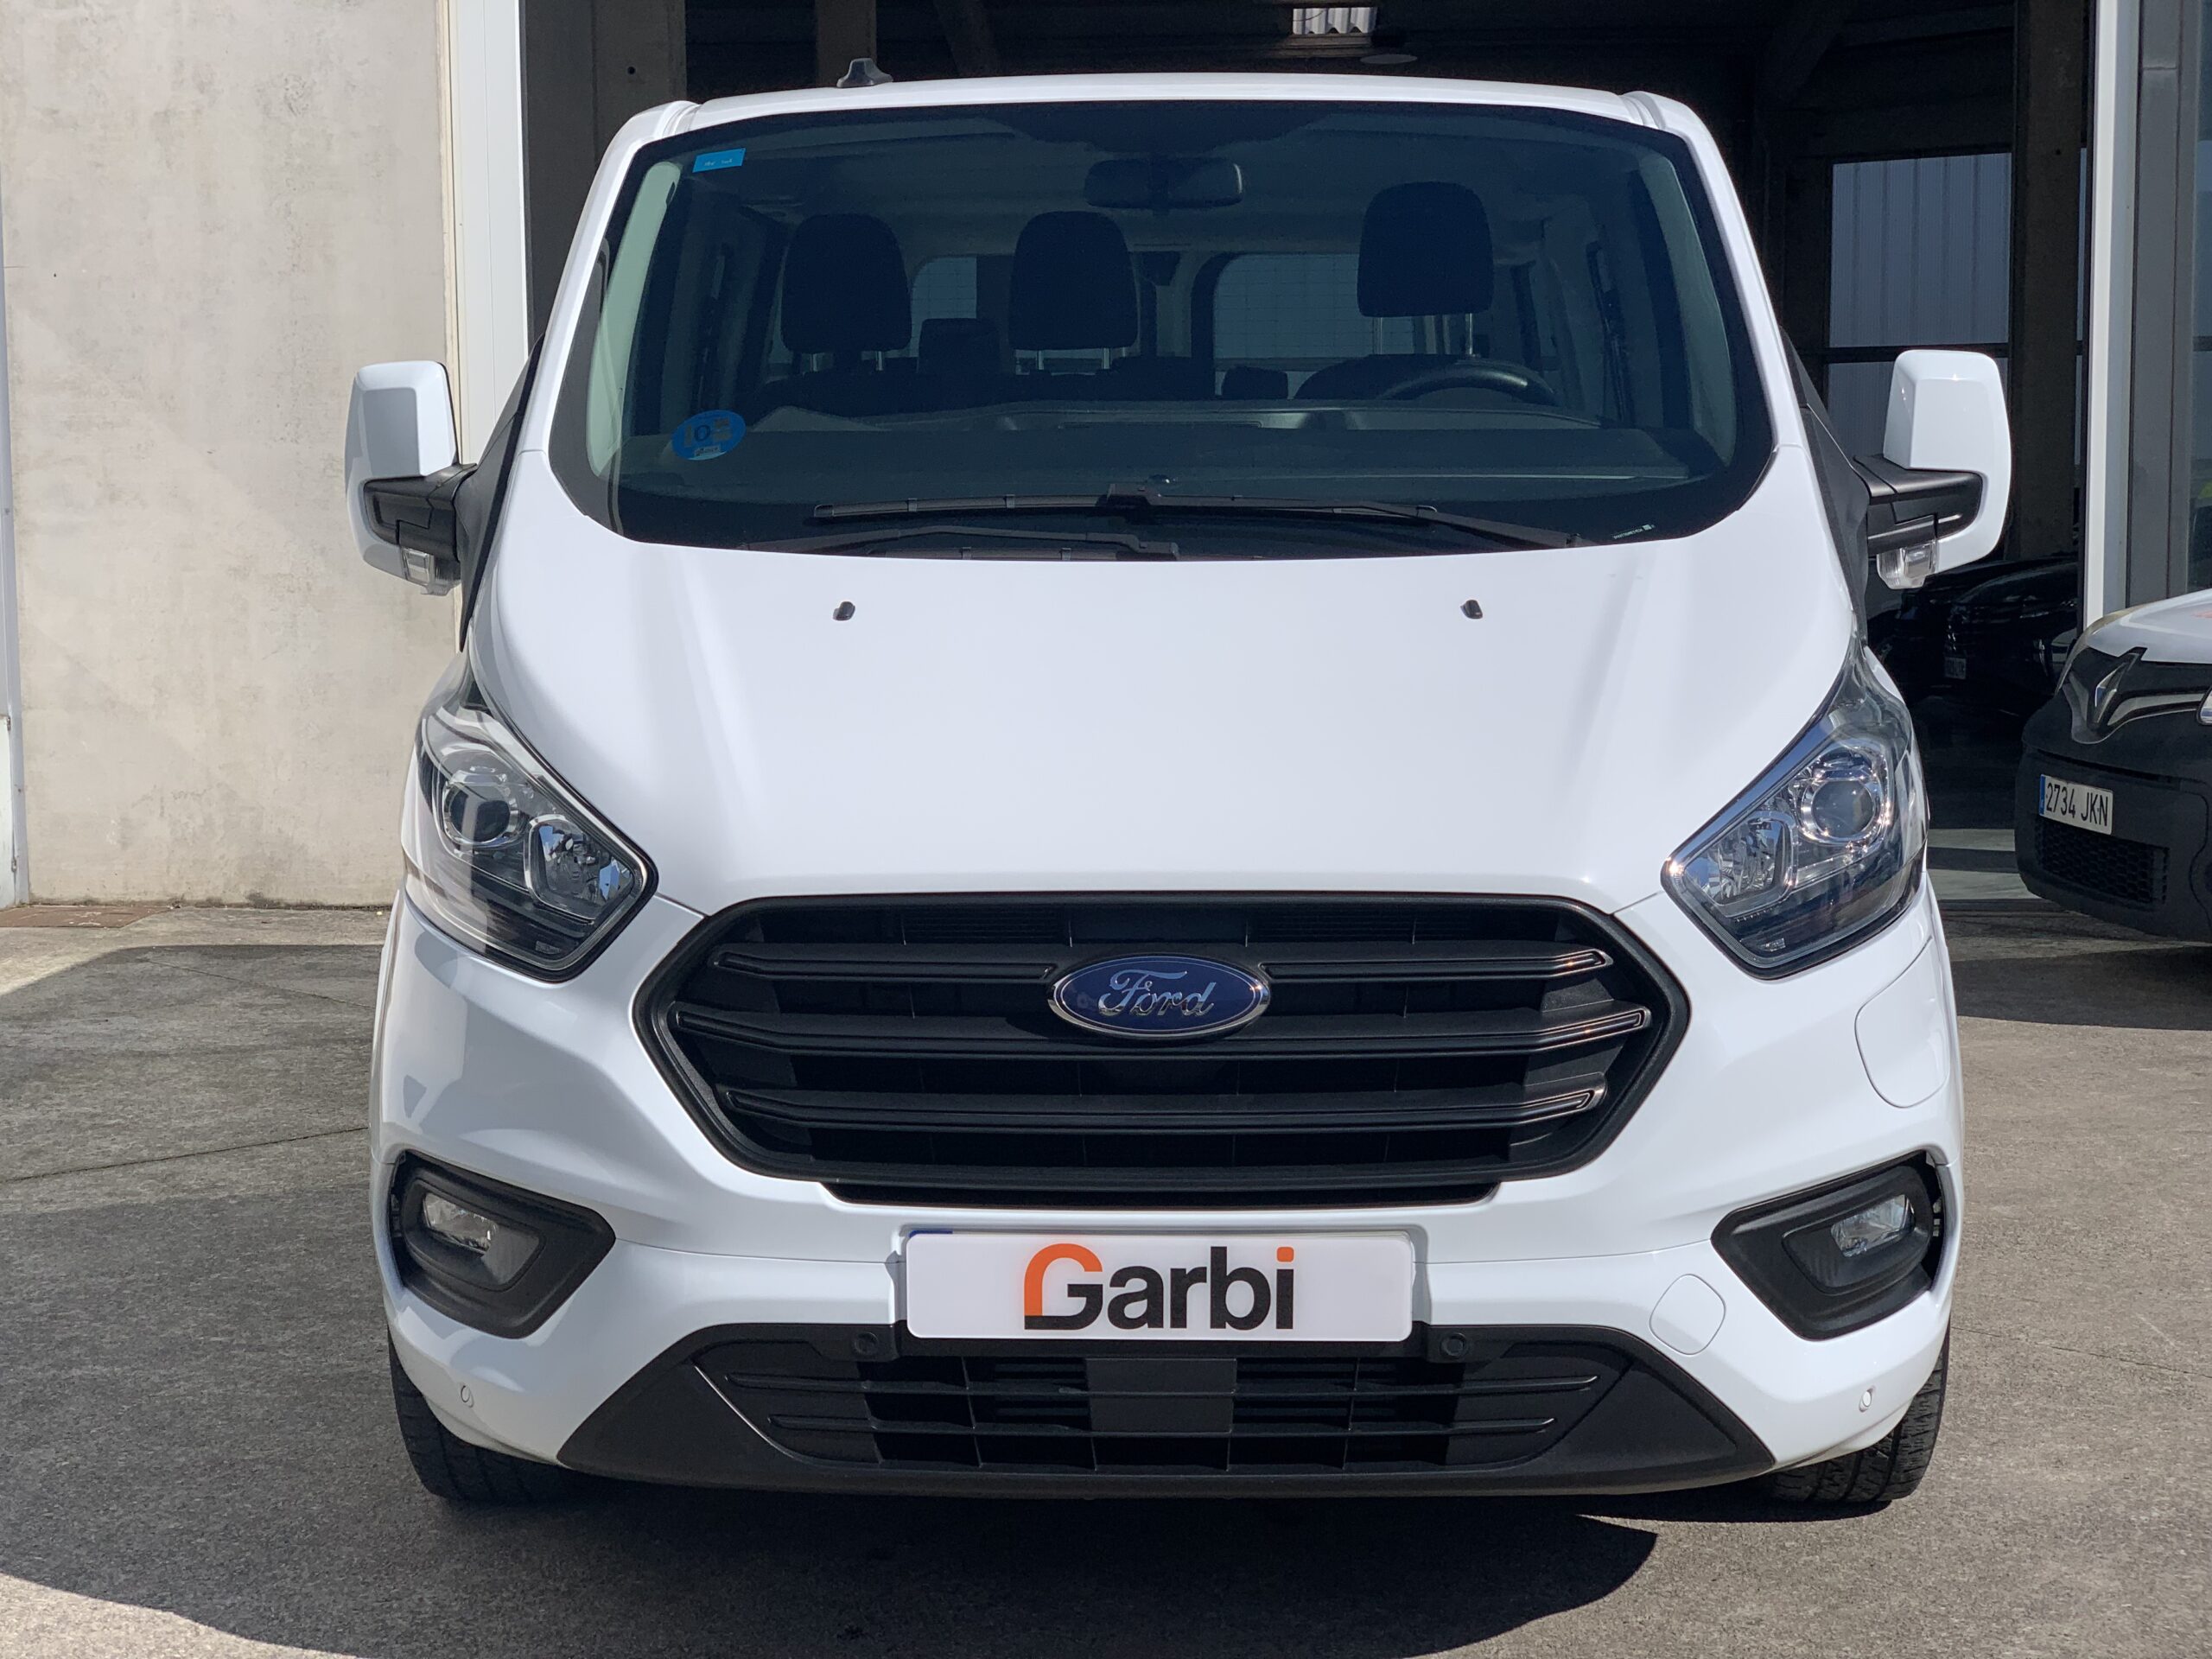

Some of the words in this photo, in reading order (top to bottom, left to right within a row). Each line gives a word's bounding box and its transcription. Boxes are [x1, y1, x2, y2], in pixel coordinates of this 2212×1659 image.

[2046, 782, 2075, 818] 2734
[2081, 791, 2108, 827] JKN
[1098, 969, 1217, 1016] Ford
[1023, 1243, 1294, 1332] Garbi
